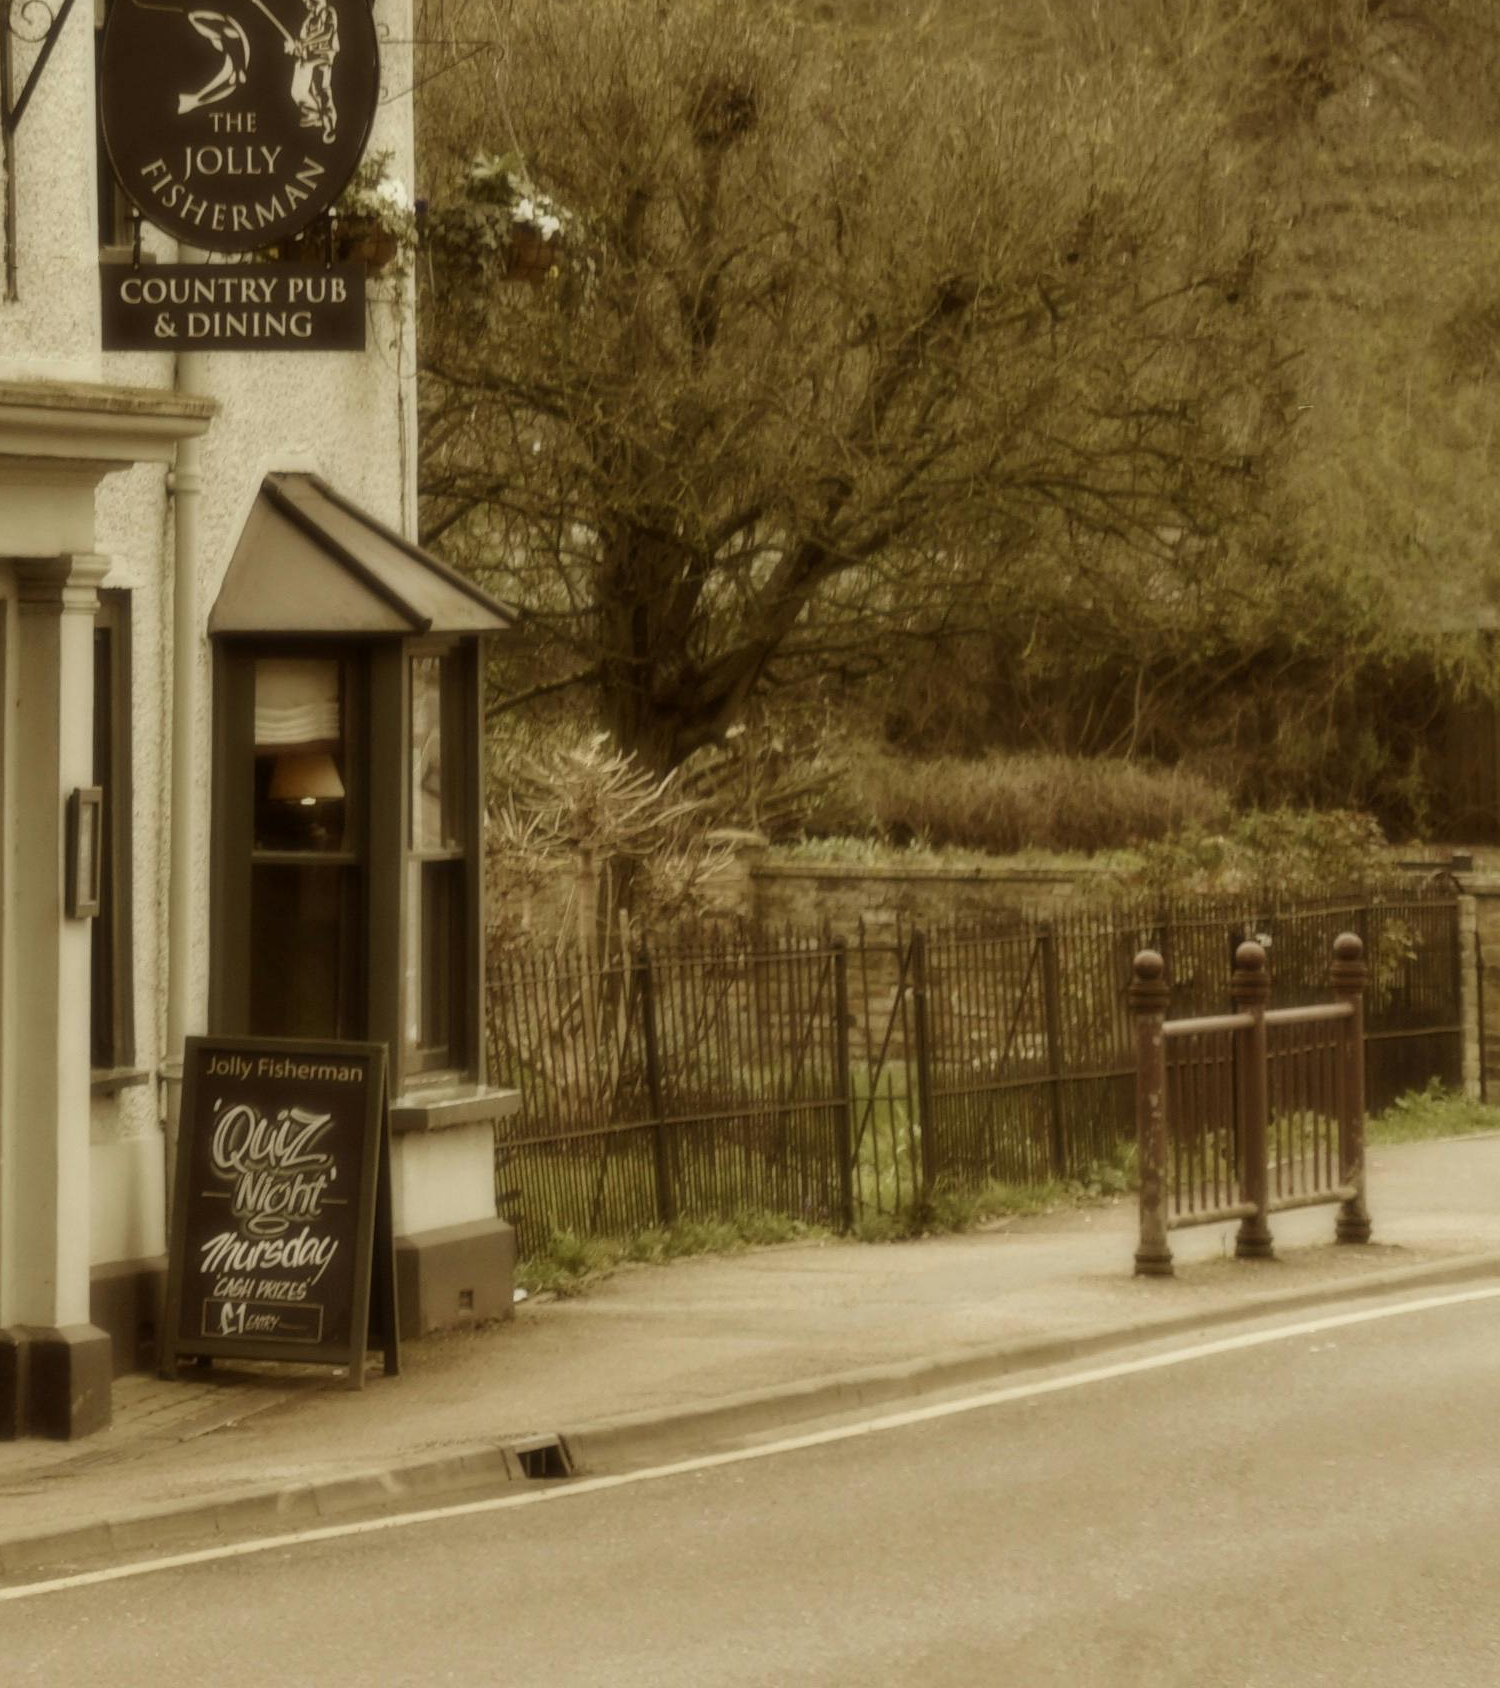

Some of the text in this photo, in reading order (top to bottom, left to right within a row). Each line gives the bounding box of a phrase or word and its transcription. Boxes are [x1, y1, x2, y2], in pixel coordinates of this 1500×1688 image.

[209, 112, 257, 133] THE
[183, 145, 283, 183] JOLLY
[141, 156, 326, 232] FISHERMAN
[120, 278, 347, 304] COUNTRY PUB
[154, 312, 312, 338] & DINING
[206, 1055, 364, 1083] Jolly Fisherman
[200, 1225, 339, 1286] Thursday
